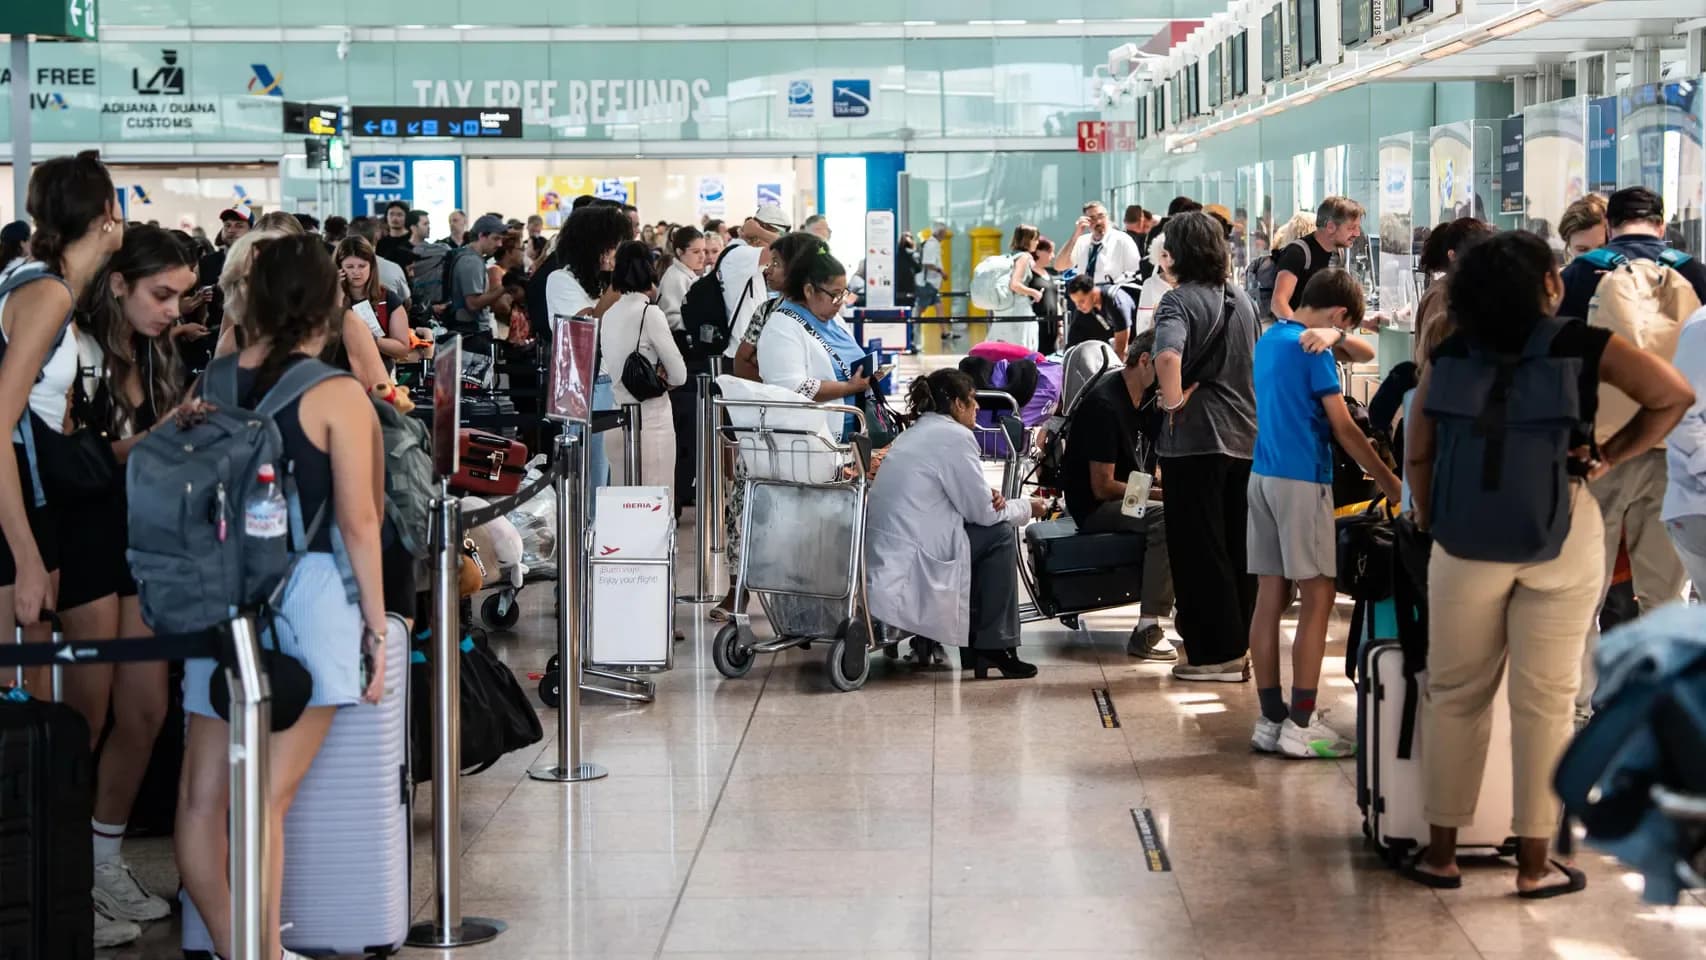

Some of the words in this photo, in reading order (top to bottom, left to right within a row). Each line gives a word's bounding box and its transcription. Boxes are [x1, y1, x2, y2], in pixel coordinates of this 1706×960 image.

[1374, 25, 1381, 35] SE
[37, 68, 96, 85] FREE
[484, 79, 558, 125] FREE
[569, 78, 711, 125] REFUNDS
[101, 103, 158, 113] ADUANA
[169, 103, 216, 113] DUANA
[126, 117, 192, 128] CUSTOMS
